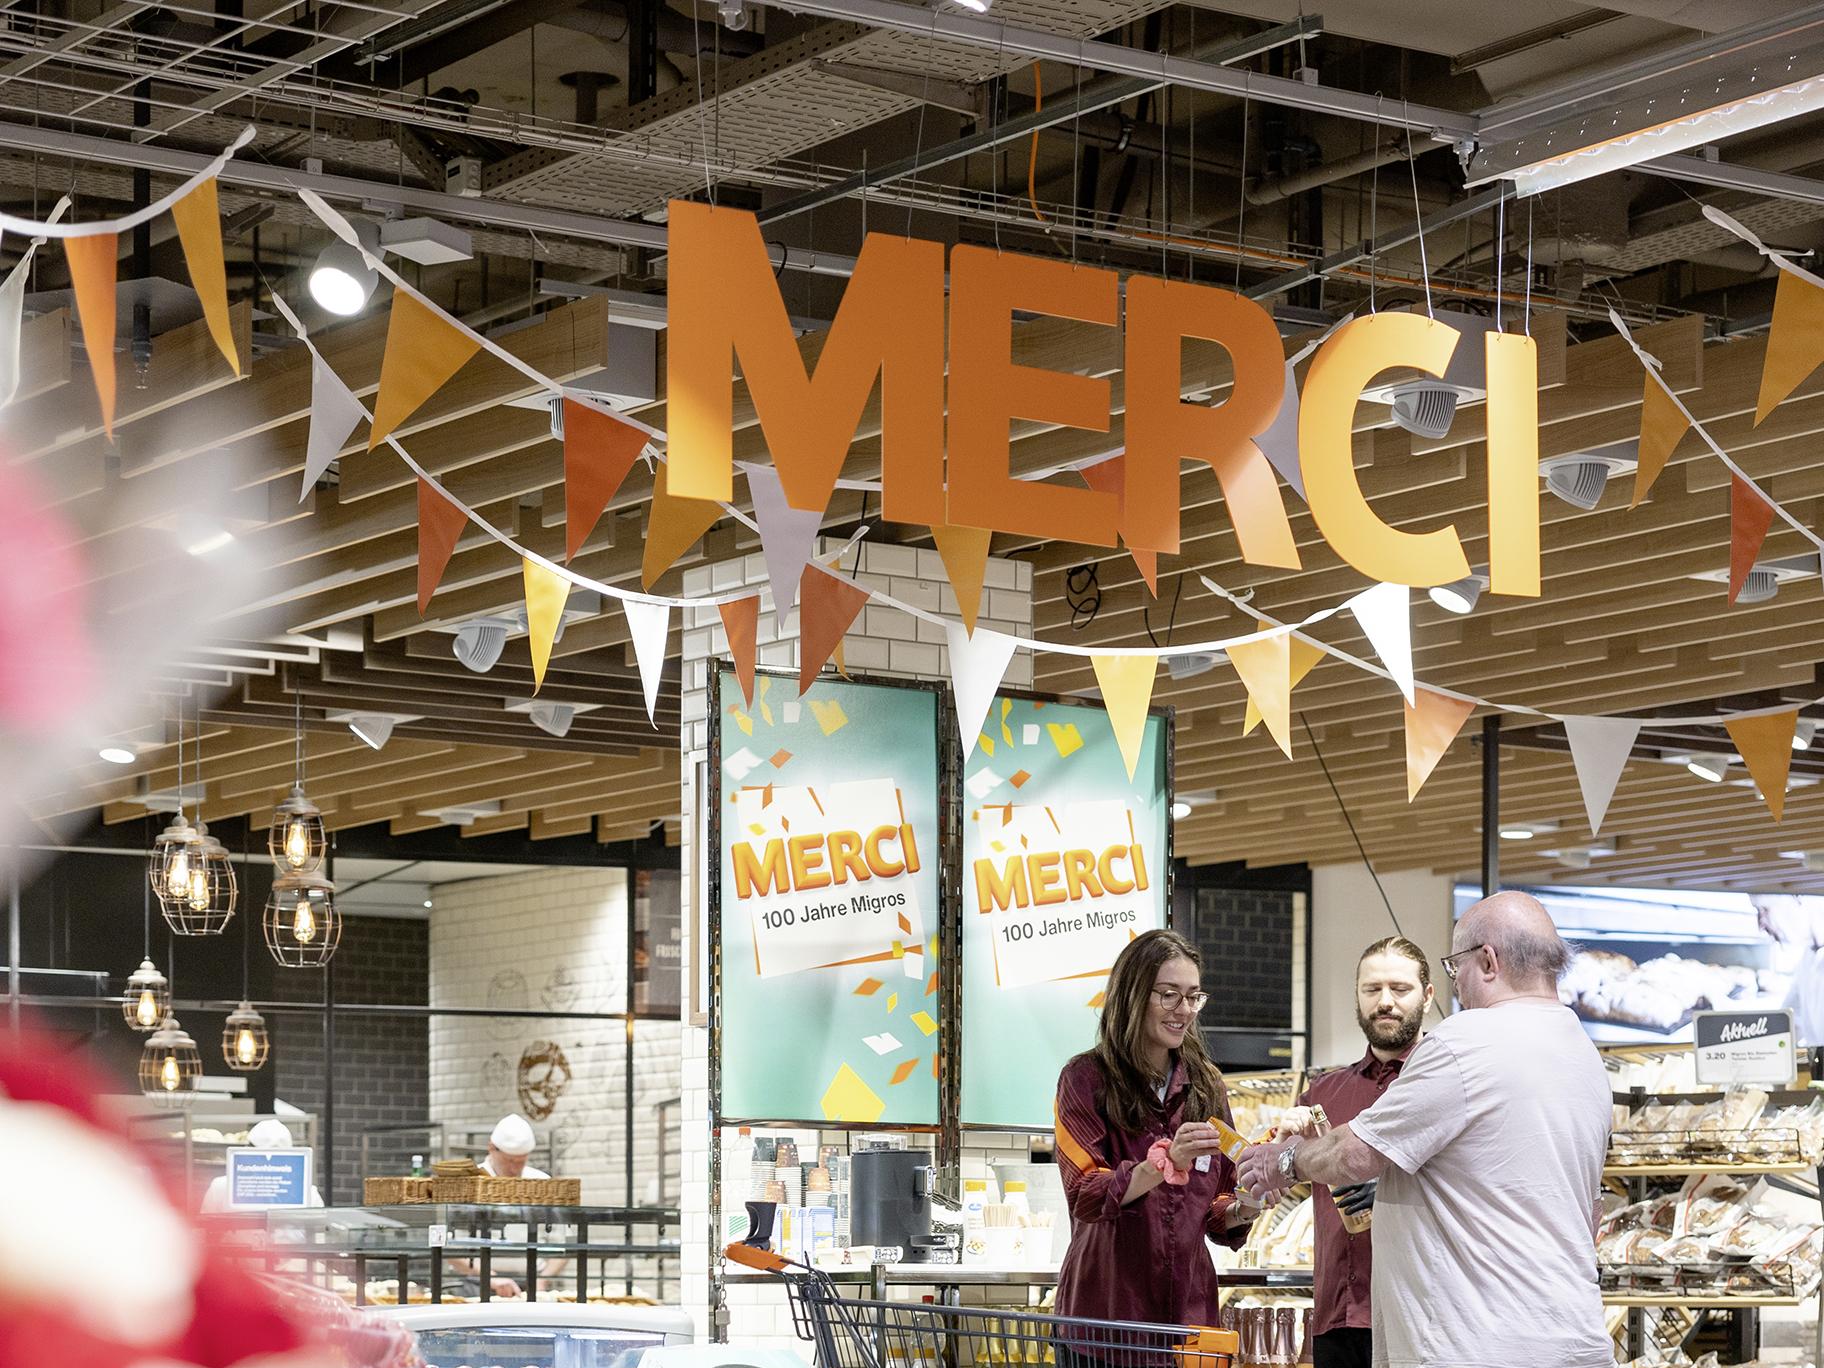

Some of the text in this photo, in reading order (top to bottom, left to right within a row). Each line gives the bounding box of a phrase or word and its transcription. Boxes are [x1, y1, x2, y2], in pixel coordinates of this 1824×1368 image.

[667, 200, 1541, 597] MERCI
[731, 823, 921, 899] MERCI
[974, 844, 1149, 914] MERCI
[762, 893, 906, 929] 100 Jahre Migros
[1002, 910, 1136, 942] 100 Jahre Migros
[1720, 1017, 1768, 1042] Aktuell
[1706, 1052, 1726, 1060] 3.20
